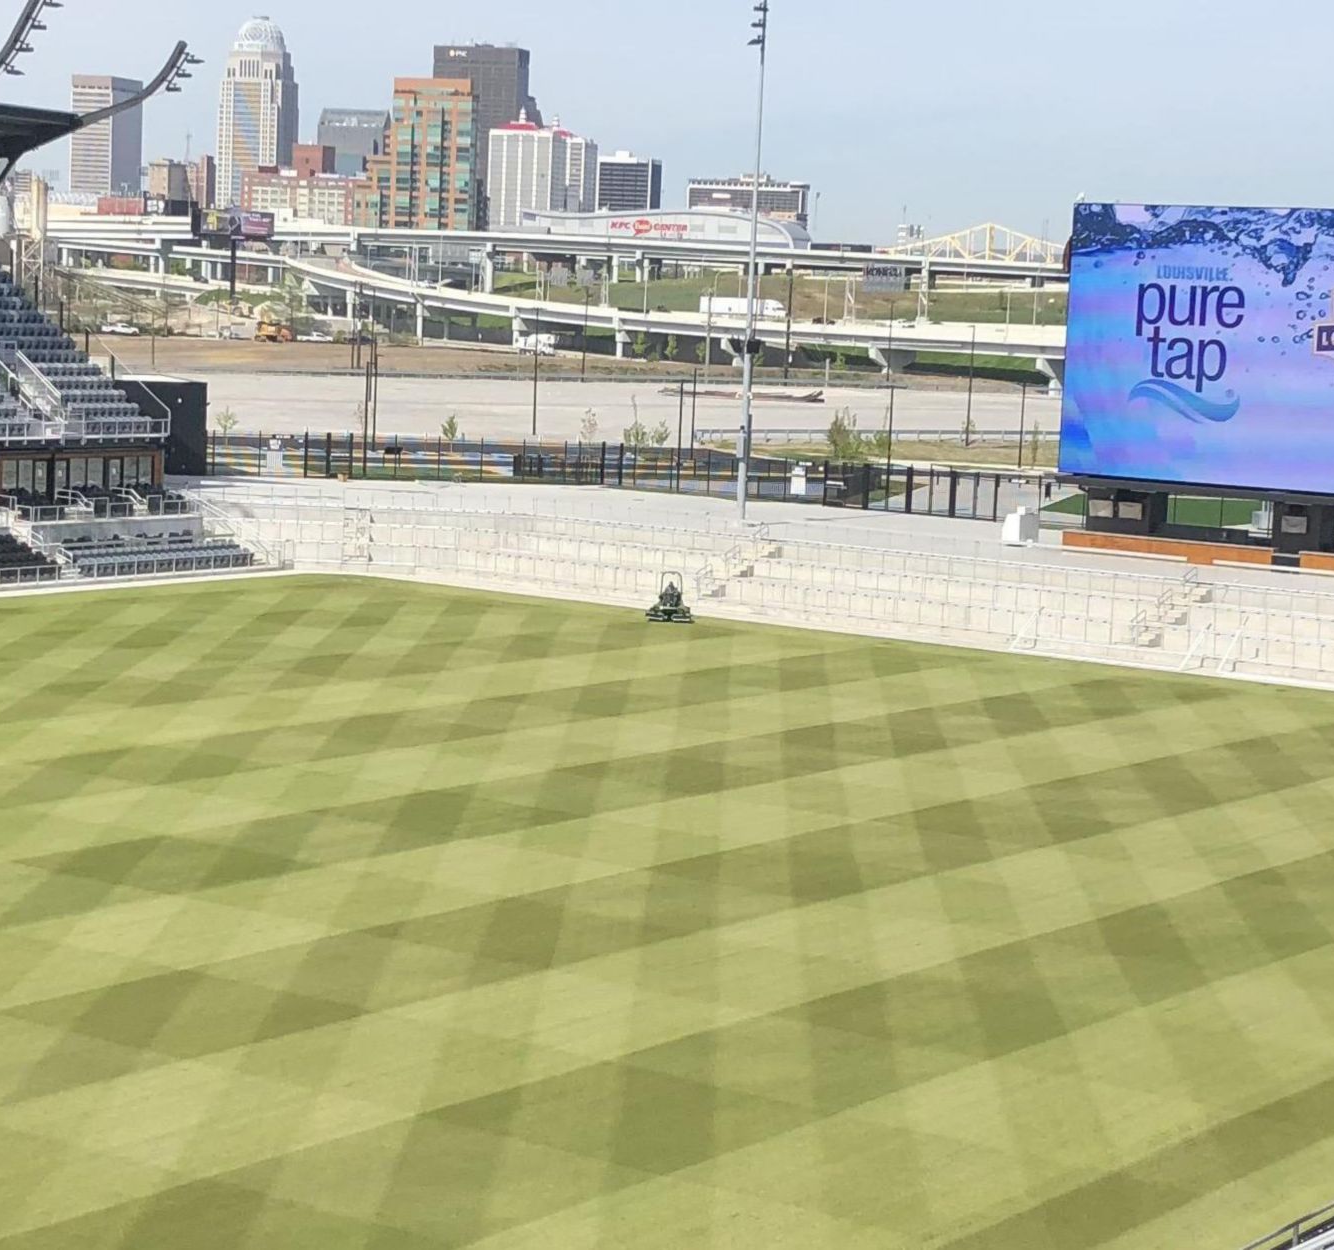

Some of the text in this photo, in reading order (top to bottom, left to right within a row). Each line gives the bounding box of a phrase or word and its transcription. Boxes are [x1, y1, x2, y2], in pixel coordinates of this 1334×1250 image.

[653, 223, 688, 232] CENTER
[1156, 264, 1229, 281] LOUISVILLE
[1135, 282, 1245, 337] pure
[1147, 325, 1227, 393] tap
